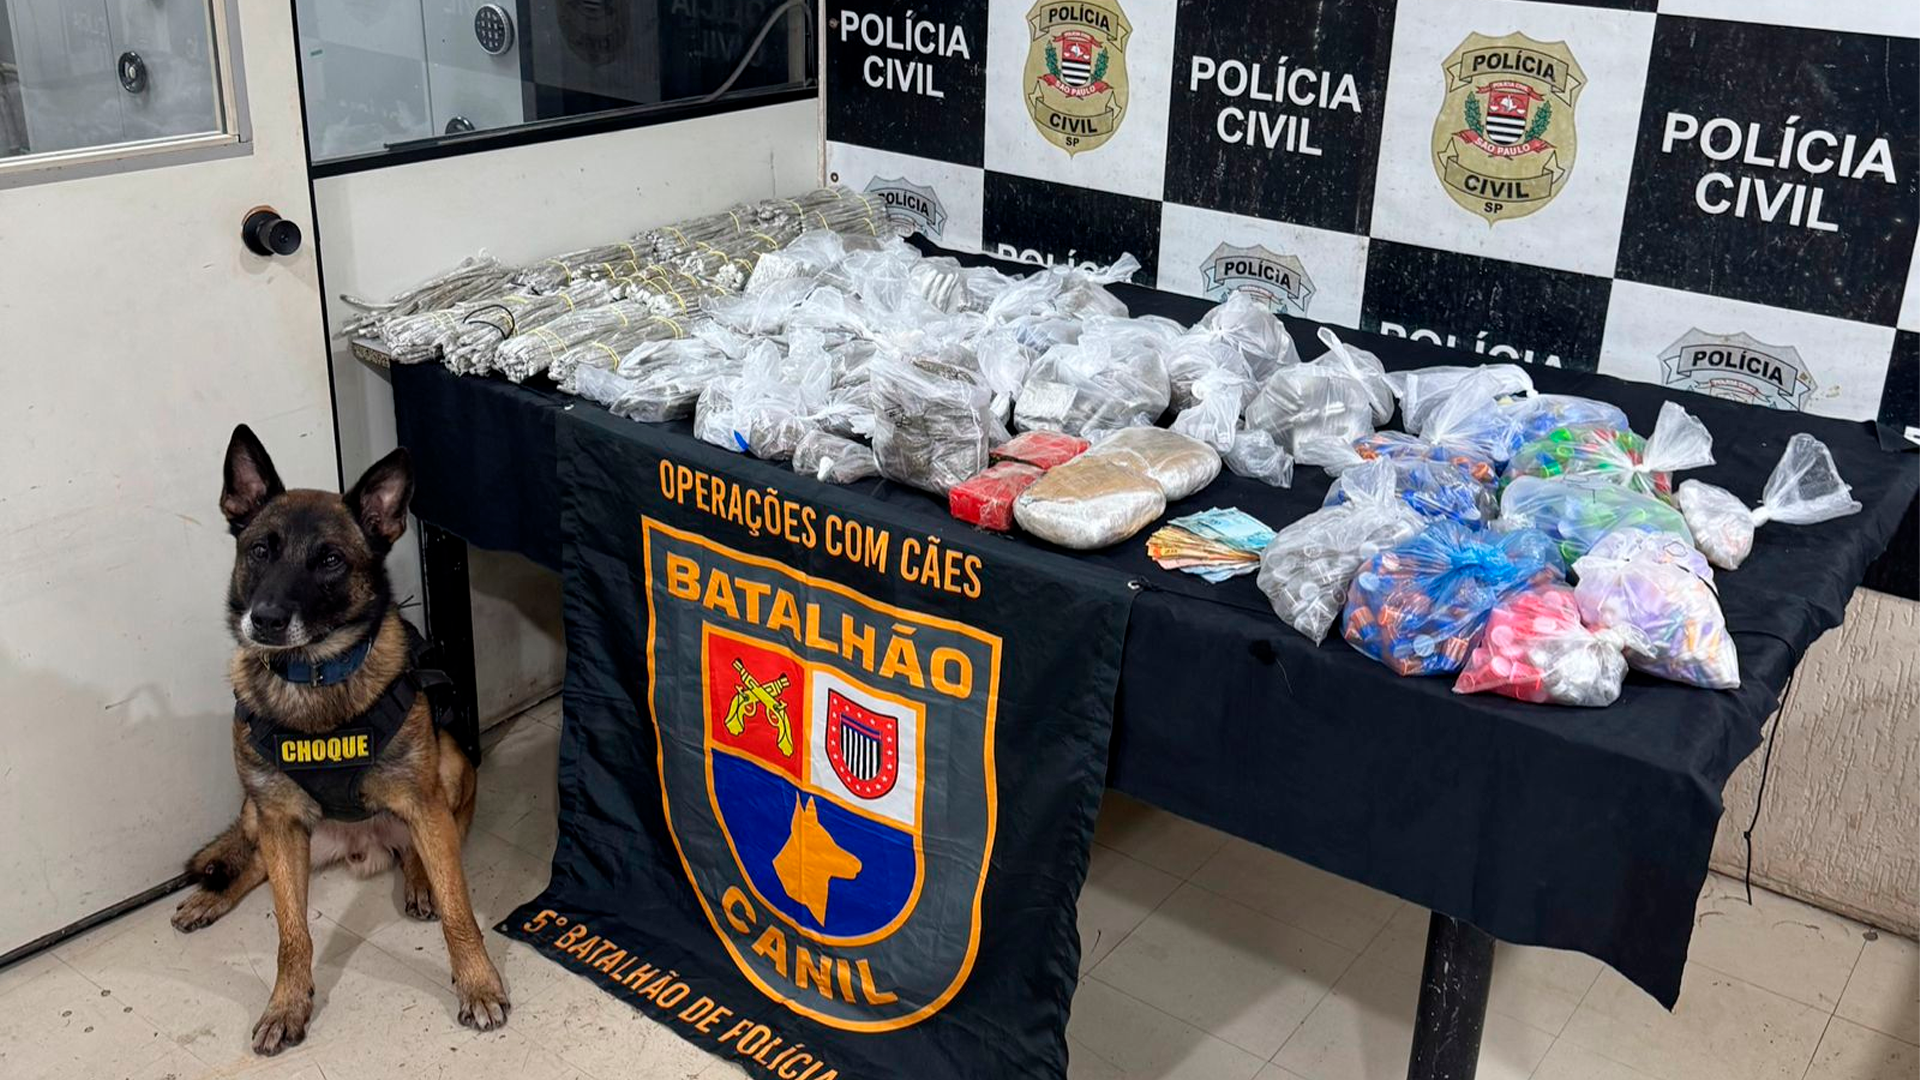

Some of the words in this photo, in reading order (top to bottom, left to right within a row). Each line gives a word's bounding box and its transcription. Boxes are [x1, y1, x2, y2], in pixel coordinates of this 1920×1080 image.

[841, 10, 970, 60] POLÍCIA
[1048, 4, 1111, 31] POLÍCIA
[863, 55, 944, 98] CIVIL
[1190, 55, 1362, 113] POLÍCIA
[1472, 50, 1556, 82] POLÍCIA
[1049, 113, 1098, 133] CIVIL
[1065, 136, 1080, 147] SP
[1216, 106, 1322, 156] CIVIL
[1497, 143, 1530, 156] PAULO
[1662, 112, 1897, 184] POLÍCIA
[1464, 174, 1529, 199] CIVIL
[1695, 172, 1839, 232] CIVIL
[1484, 202, 1503, 214] SP
[1224, 260, 1292, 290] POLÍCIA
[1691, 349, 1784, 386] POLÍCIA
[659, 460, 817, 549] OPERAÇÕES
[825, 515, 890, 574] COM
[900, 535, 982, 599] CÃES
[666, 552, 973, 700] BATALHÃO
[281, 735, 369, 763] CHOQUE
[722, 885, 899, 1005] CANIL
[554, 924, 691, 1009] BATALHÃO
[678, 996, 734, 1034] DE
